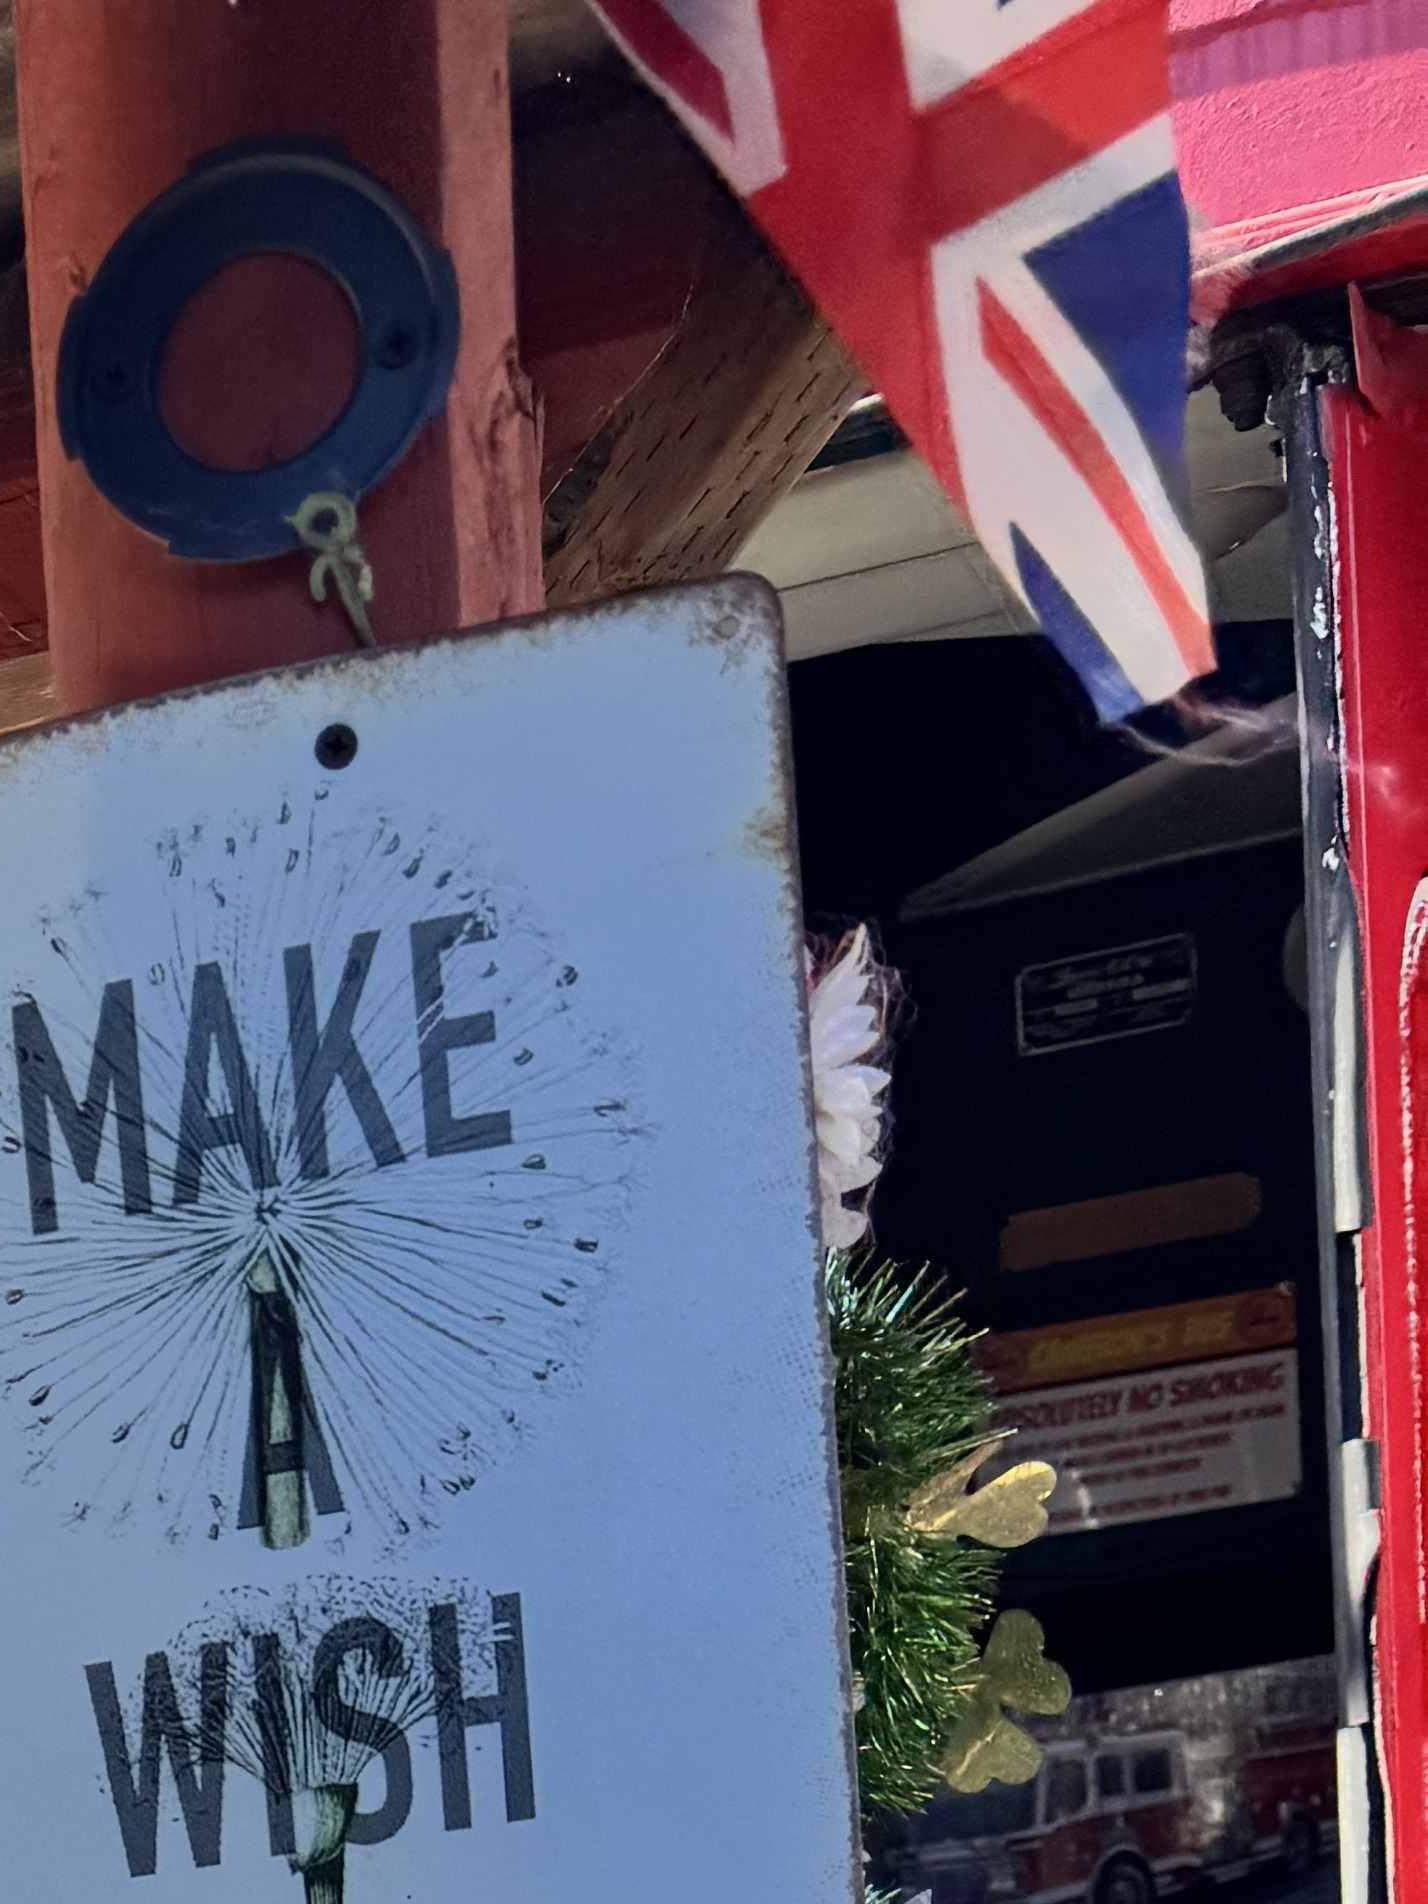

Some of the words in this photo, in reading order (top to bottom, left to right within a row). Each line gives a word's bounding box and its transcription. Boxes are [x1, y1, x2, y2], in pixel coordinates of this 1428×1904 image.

[10, 912, 515, 1234] MAKE
[236, 1286, 346, 1530] A
[82, 1591, 537, 1880] WISH
